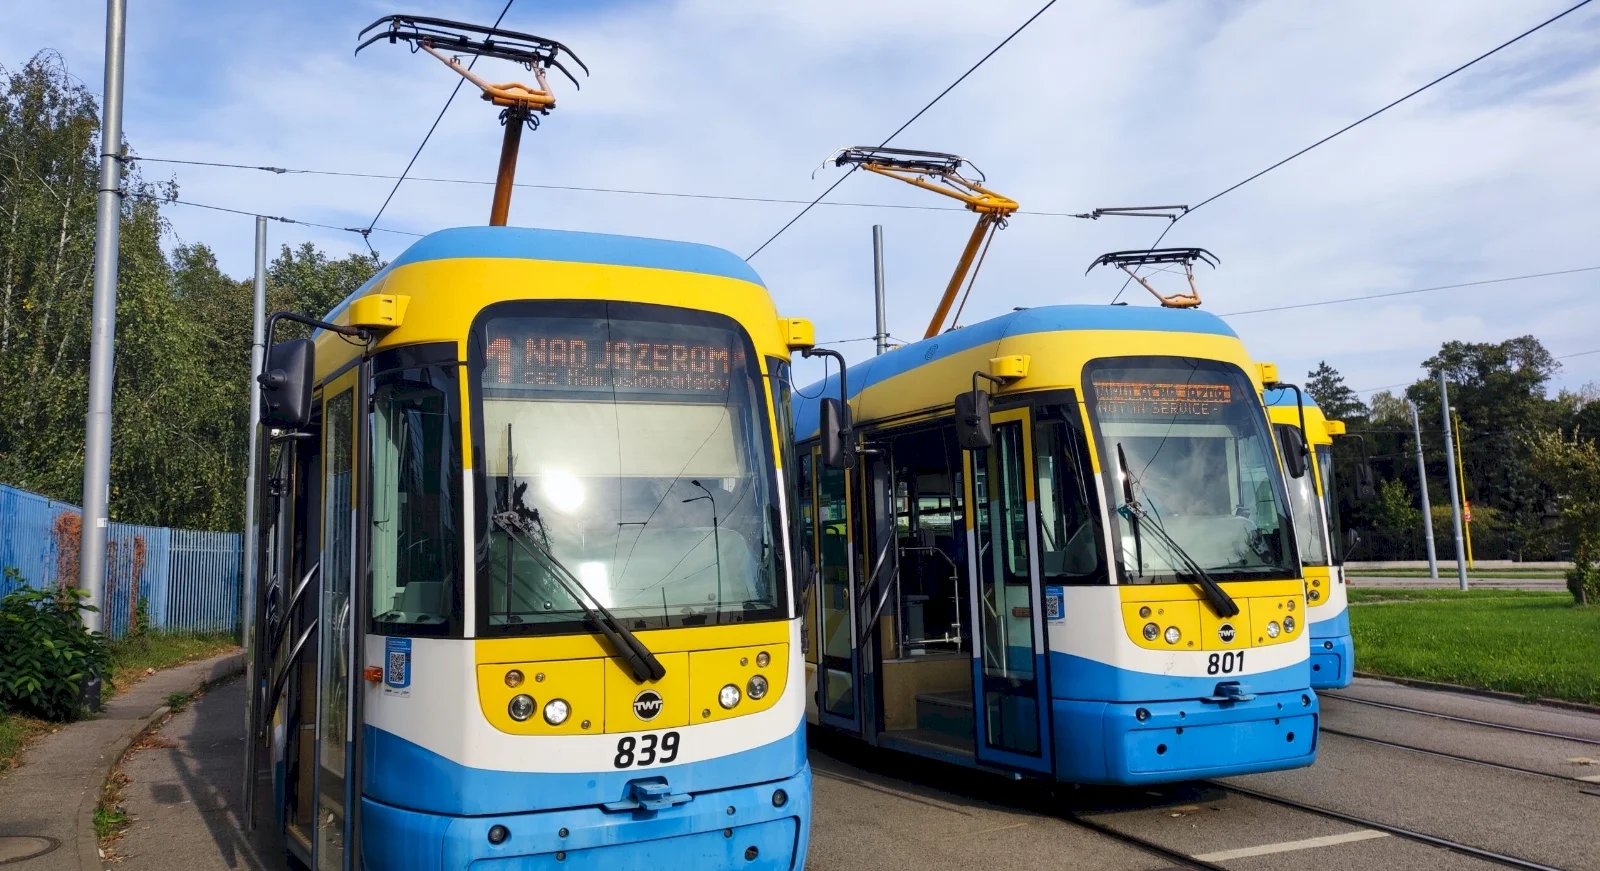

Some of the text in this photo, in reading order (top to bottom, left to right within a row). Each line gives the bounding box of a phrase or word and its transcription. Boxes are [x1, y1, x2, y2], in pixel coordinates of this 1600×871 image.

[486, 338, 729, 384] 1 NAD JAZEROM
[1098, 401, 1126, 413] NOT
[1133, 402, 1146, 413] IN
[1152, 402, 1210, 415] SERVICE
[1207, 650, 1244, 675] 801
[634, 700, 662, 711] TWT
[614, 731, 681, 769] 839
